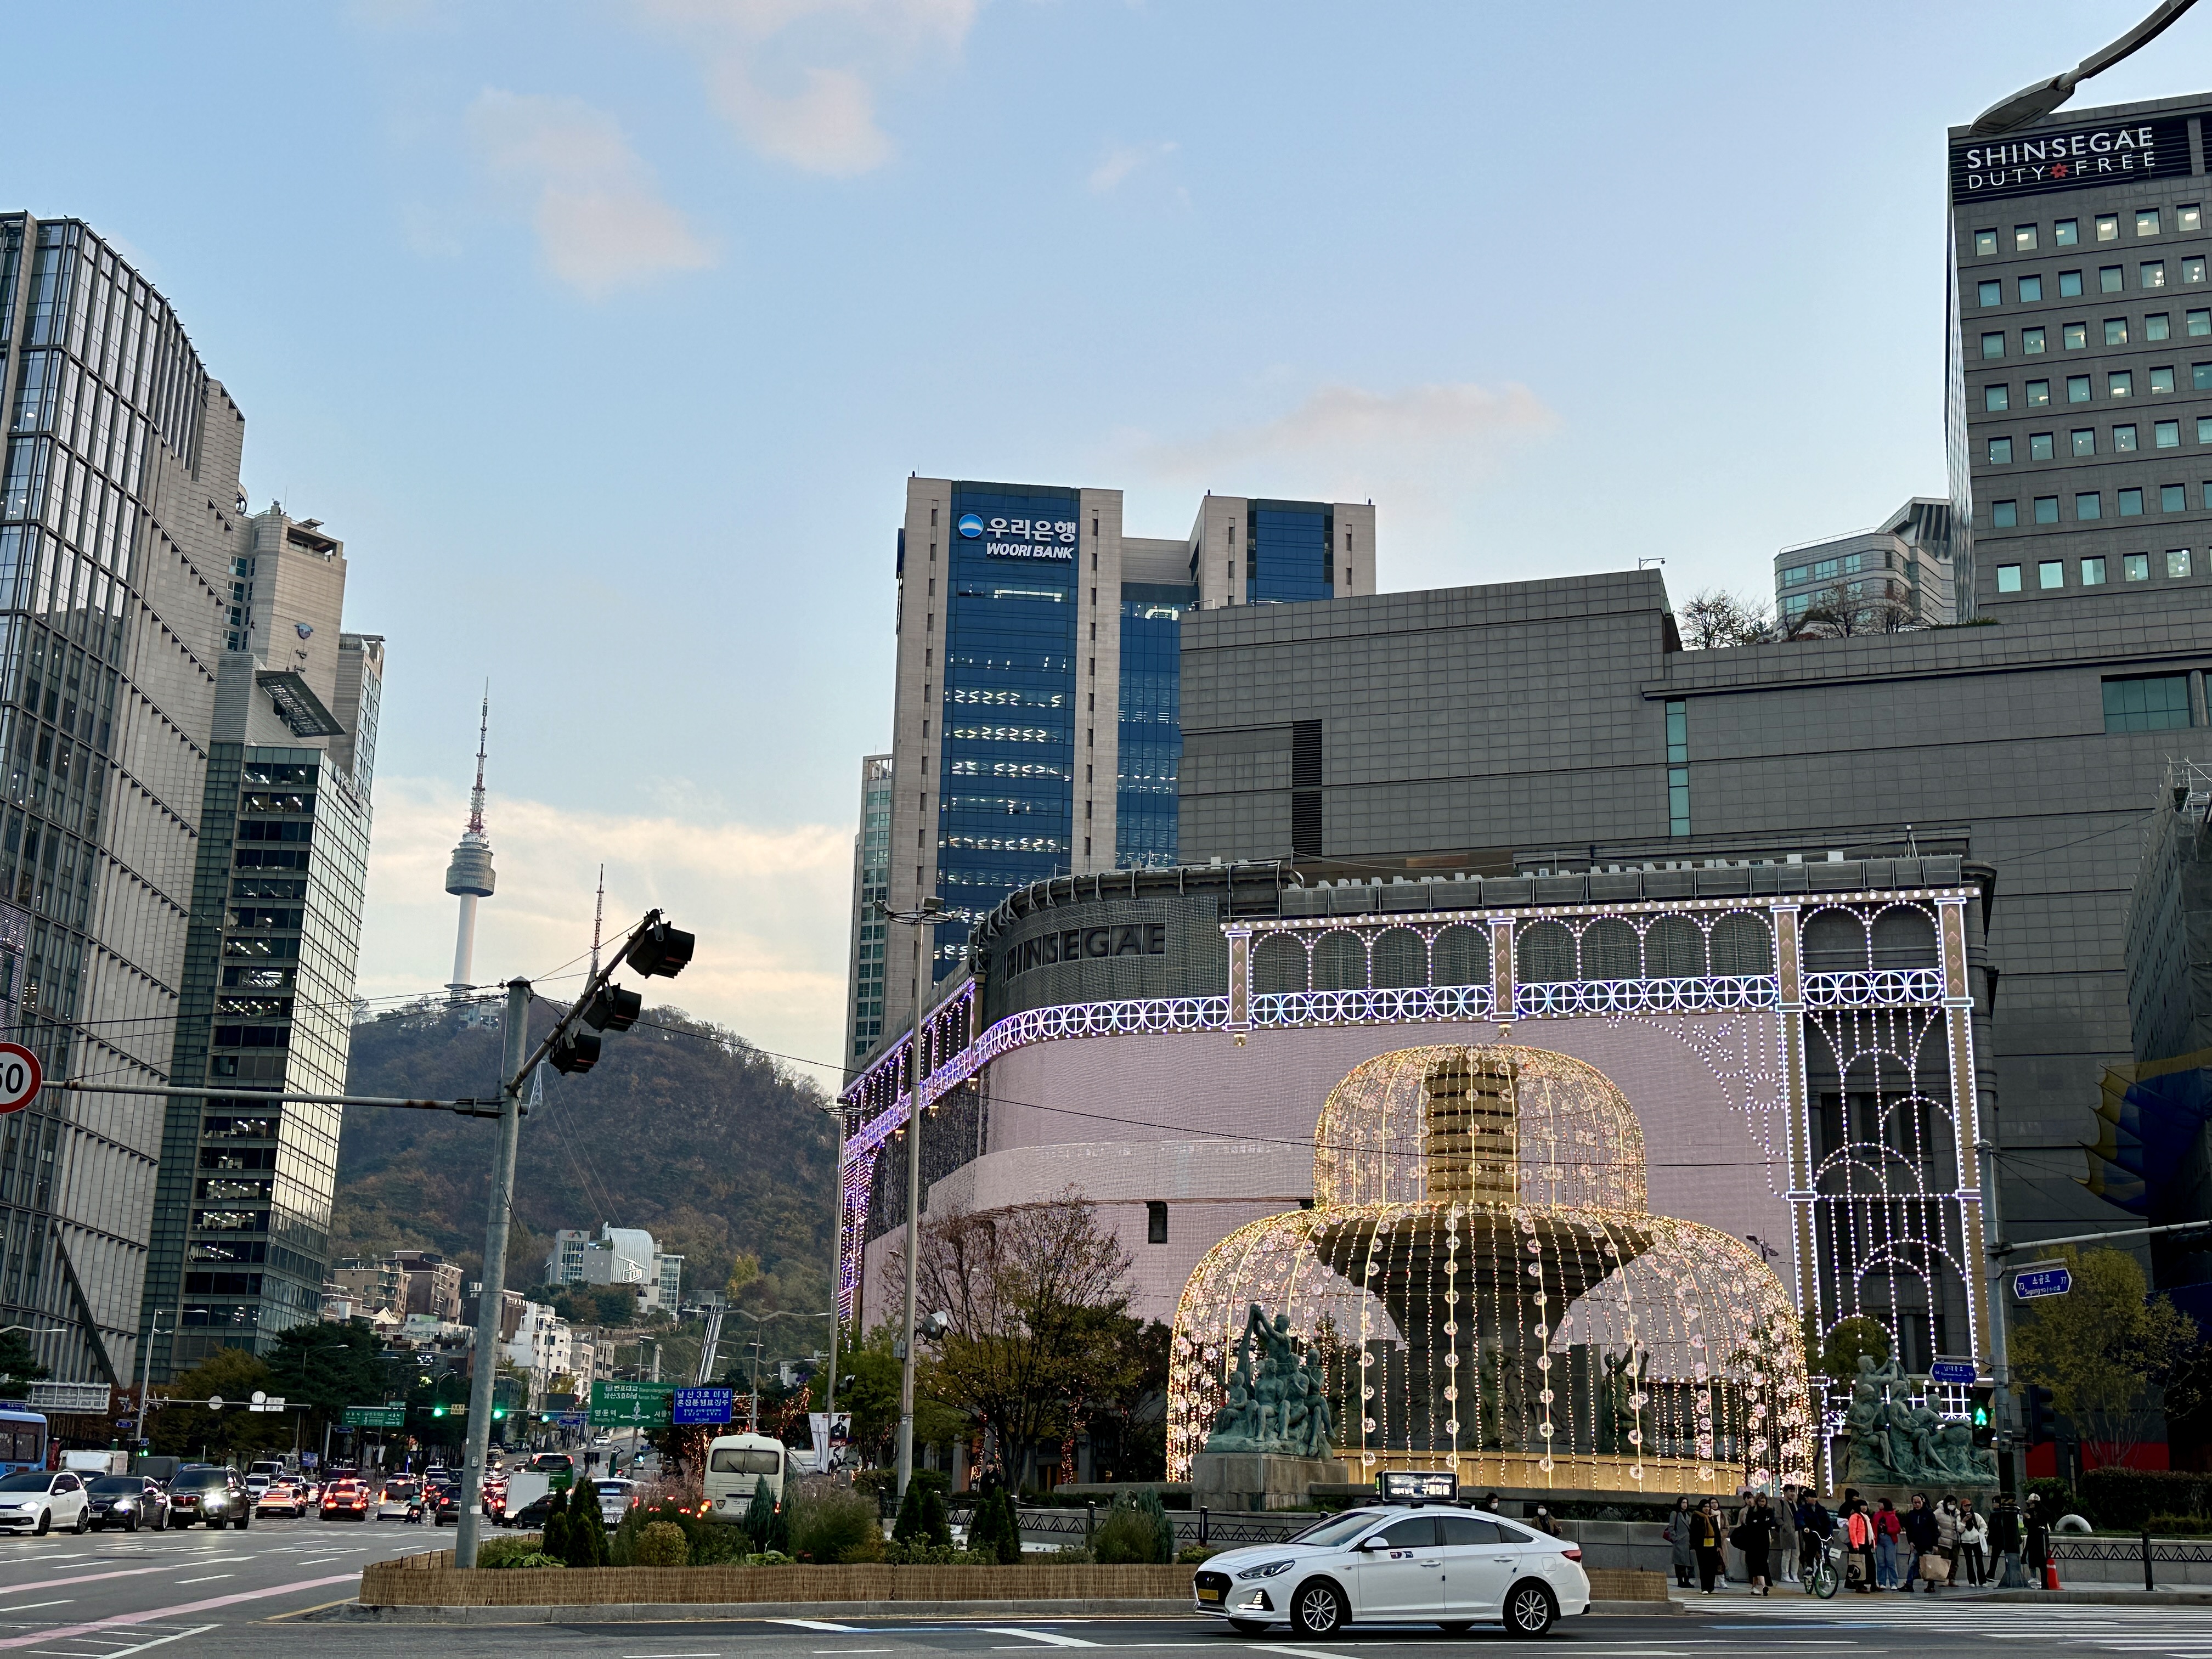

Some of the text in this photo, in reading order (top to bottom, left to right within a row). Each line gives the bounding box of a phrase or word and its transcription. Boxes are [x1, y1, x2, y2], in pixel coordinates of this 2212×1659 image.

[1967, 127, 2153, 169] SHINSEGAE
[1968, 151, 2155, 189] DUTY FREE
[987, 517, 1076, 543] 우리은행
[987, 543, 1075, 558] WOORI BANK
